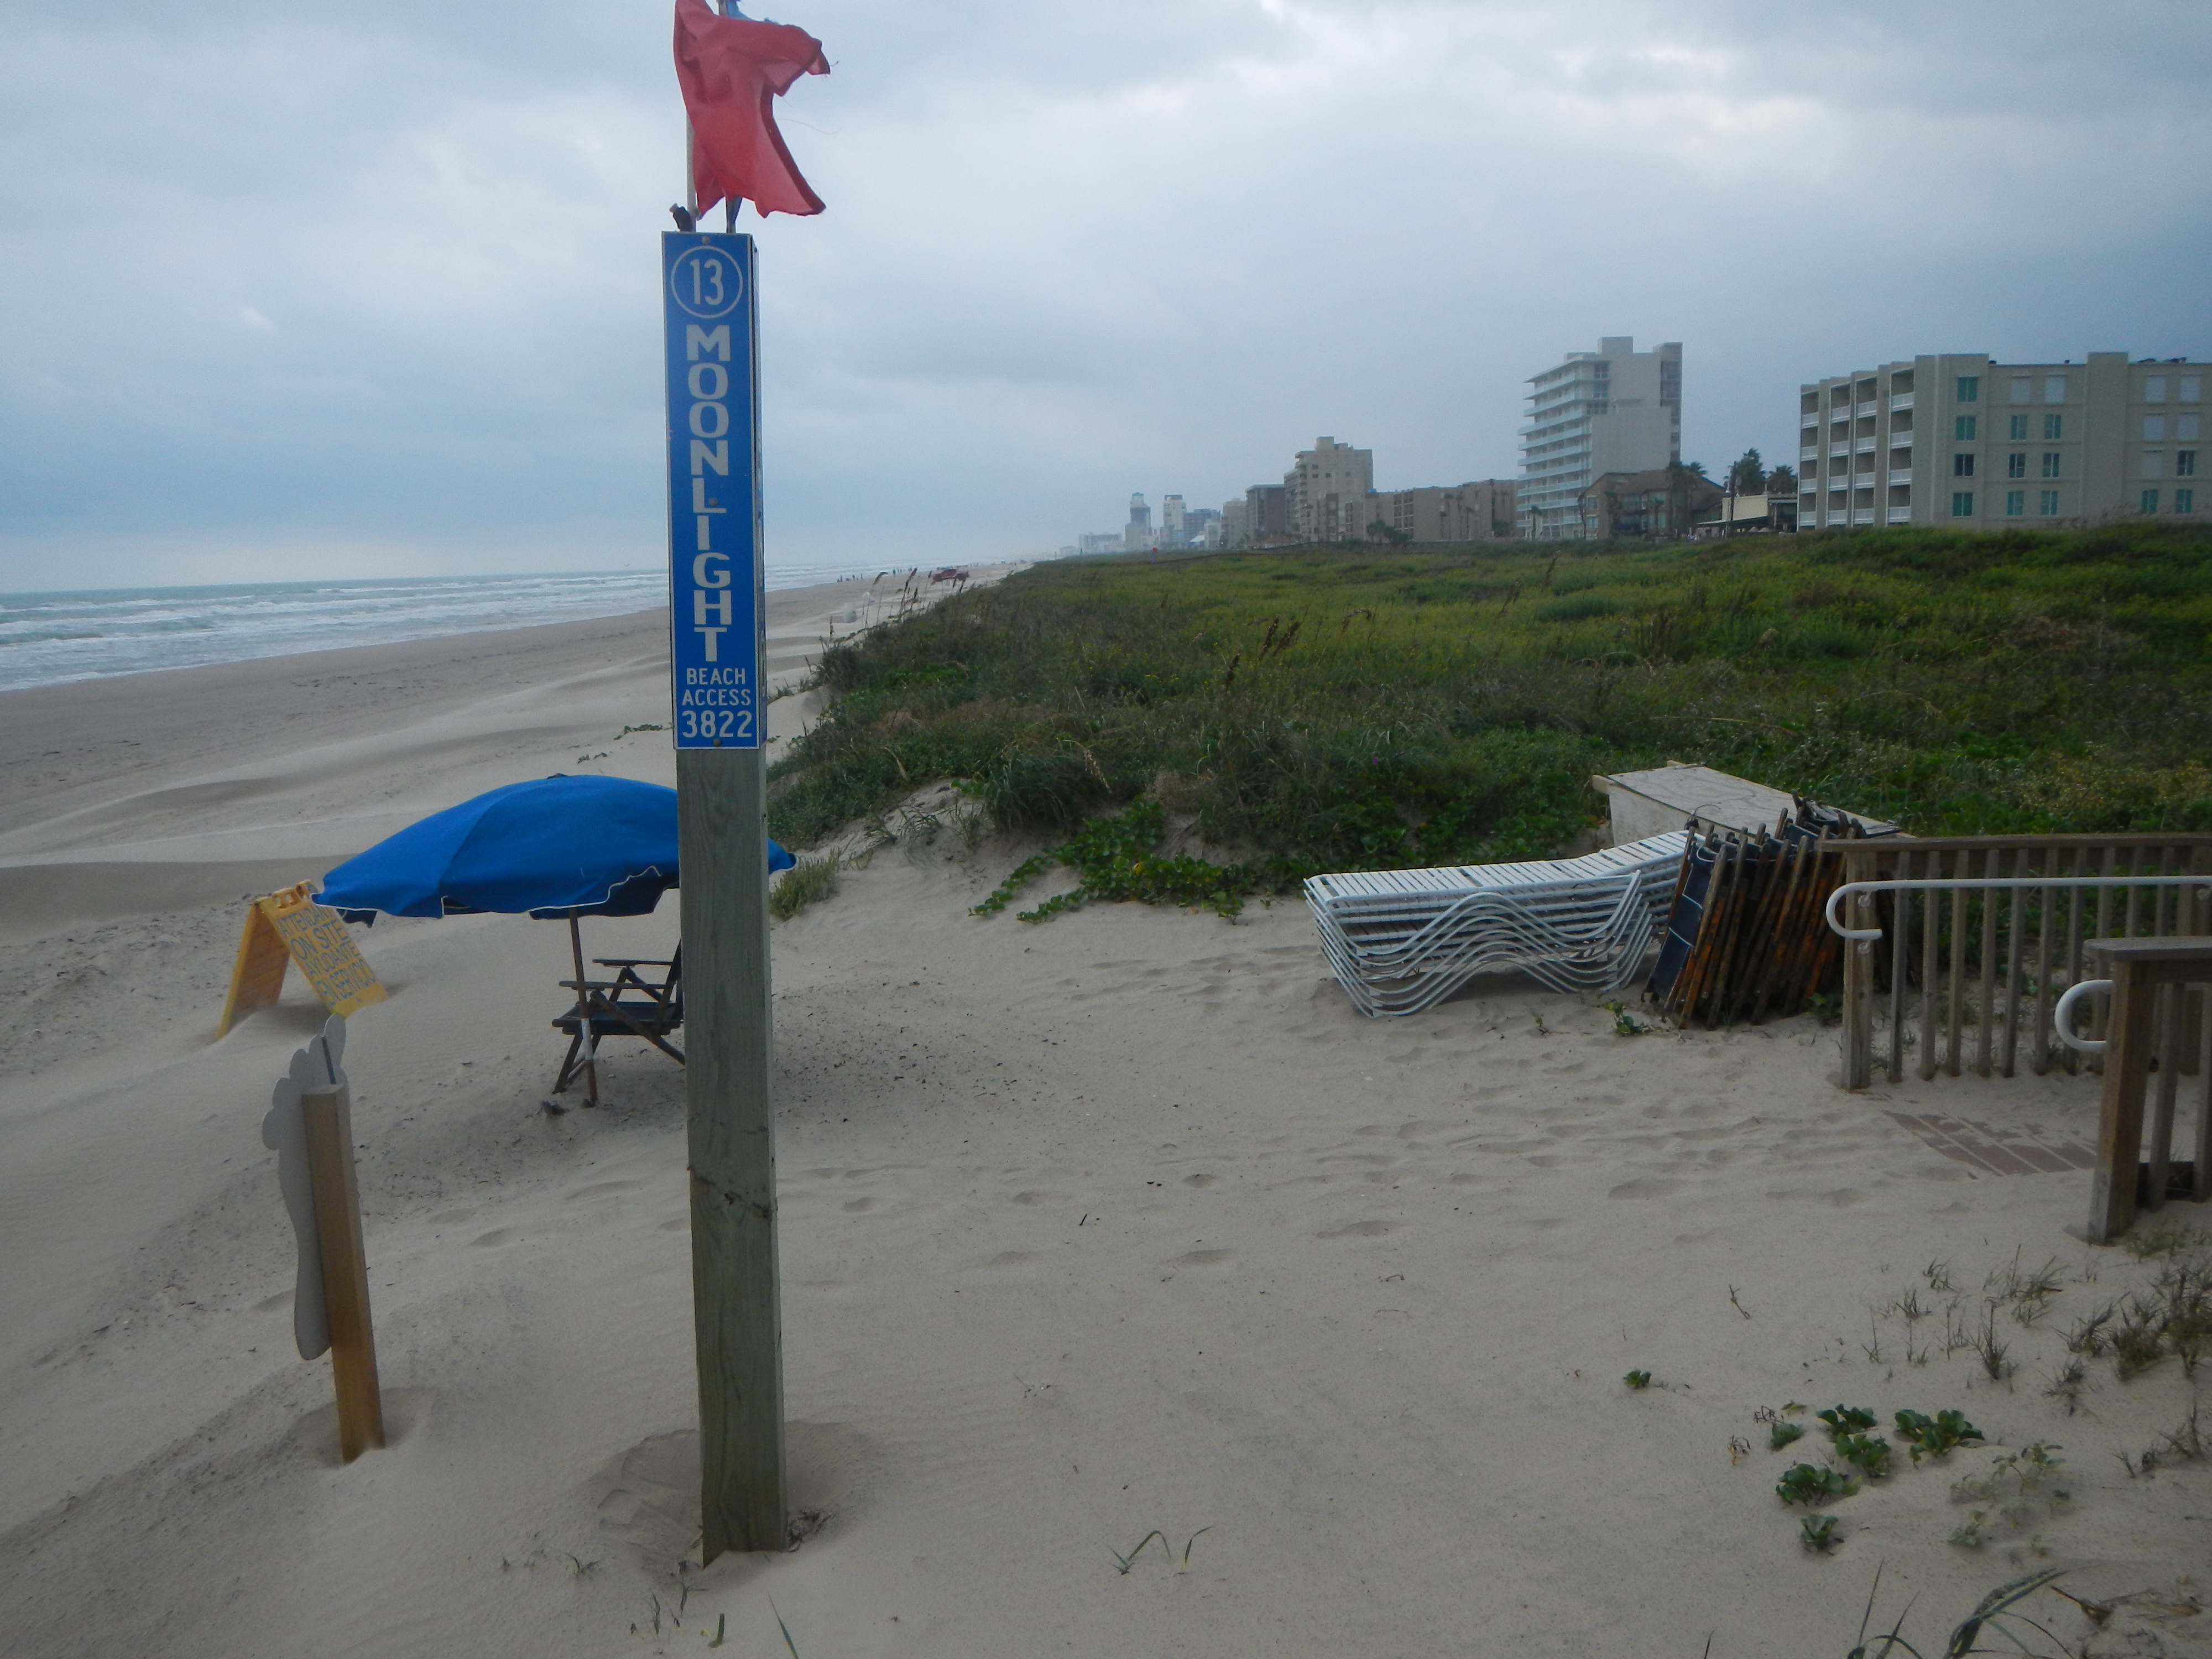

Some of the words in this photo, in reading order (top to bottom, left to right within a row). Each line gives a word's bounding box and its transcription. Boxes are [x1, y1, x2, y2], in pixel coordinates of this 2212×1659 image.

[690, 258, 724, 306] 13
[686, 324, 732, 661] MOONLIGHT
[686, 667, 745, 685] BEACH
[681, 688, 752, 706] ACCESS
[681, 709, 753, 738] 3822
[290, 933, 319, 961] ON
[313, 919, 348, 950] SITE
